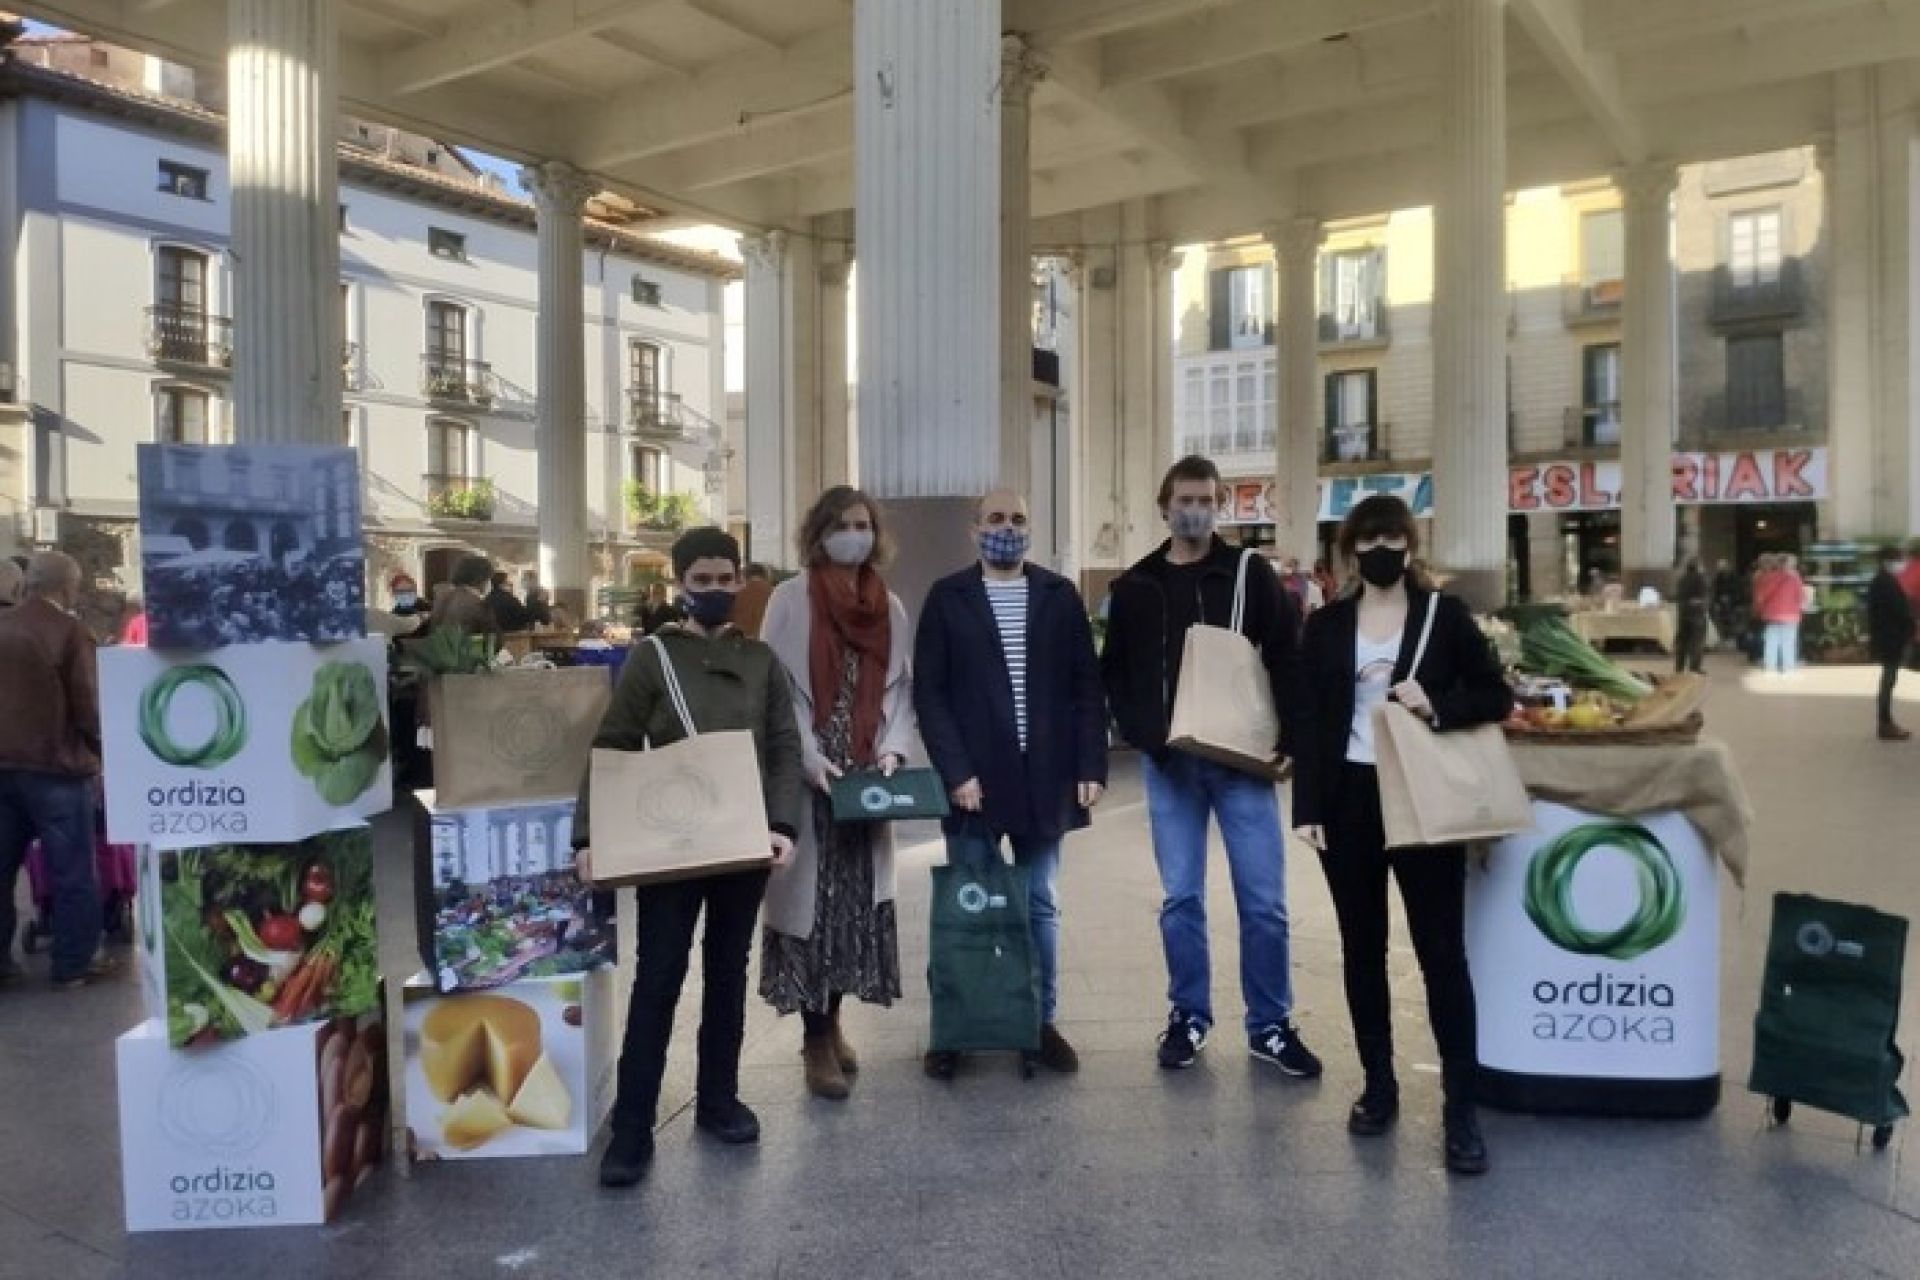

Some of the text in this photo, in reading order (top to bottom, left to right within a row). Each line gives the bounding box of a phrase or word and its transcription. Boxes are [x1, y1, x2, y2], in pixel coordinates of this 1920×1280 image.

[147, 780, 245, 806] ordizia
[149, 811, 248, 834] azoka
[1533, 972, 1674, 1007] ordizia
[1533, 1012, 1674, 1043] azoka
[169, 1165, 275, 1193] ordizia
[171, 1197, 277, 1221] azoka
